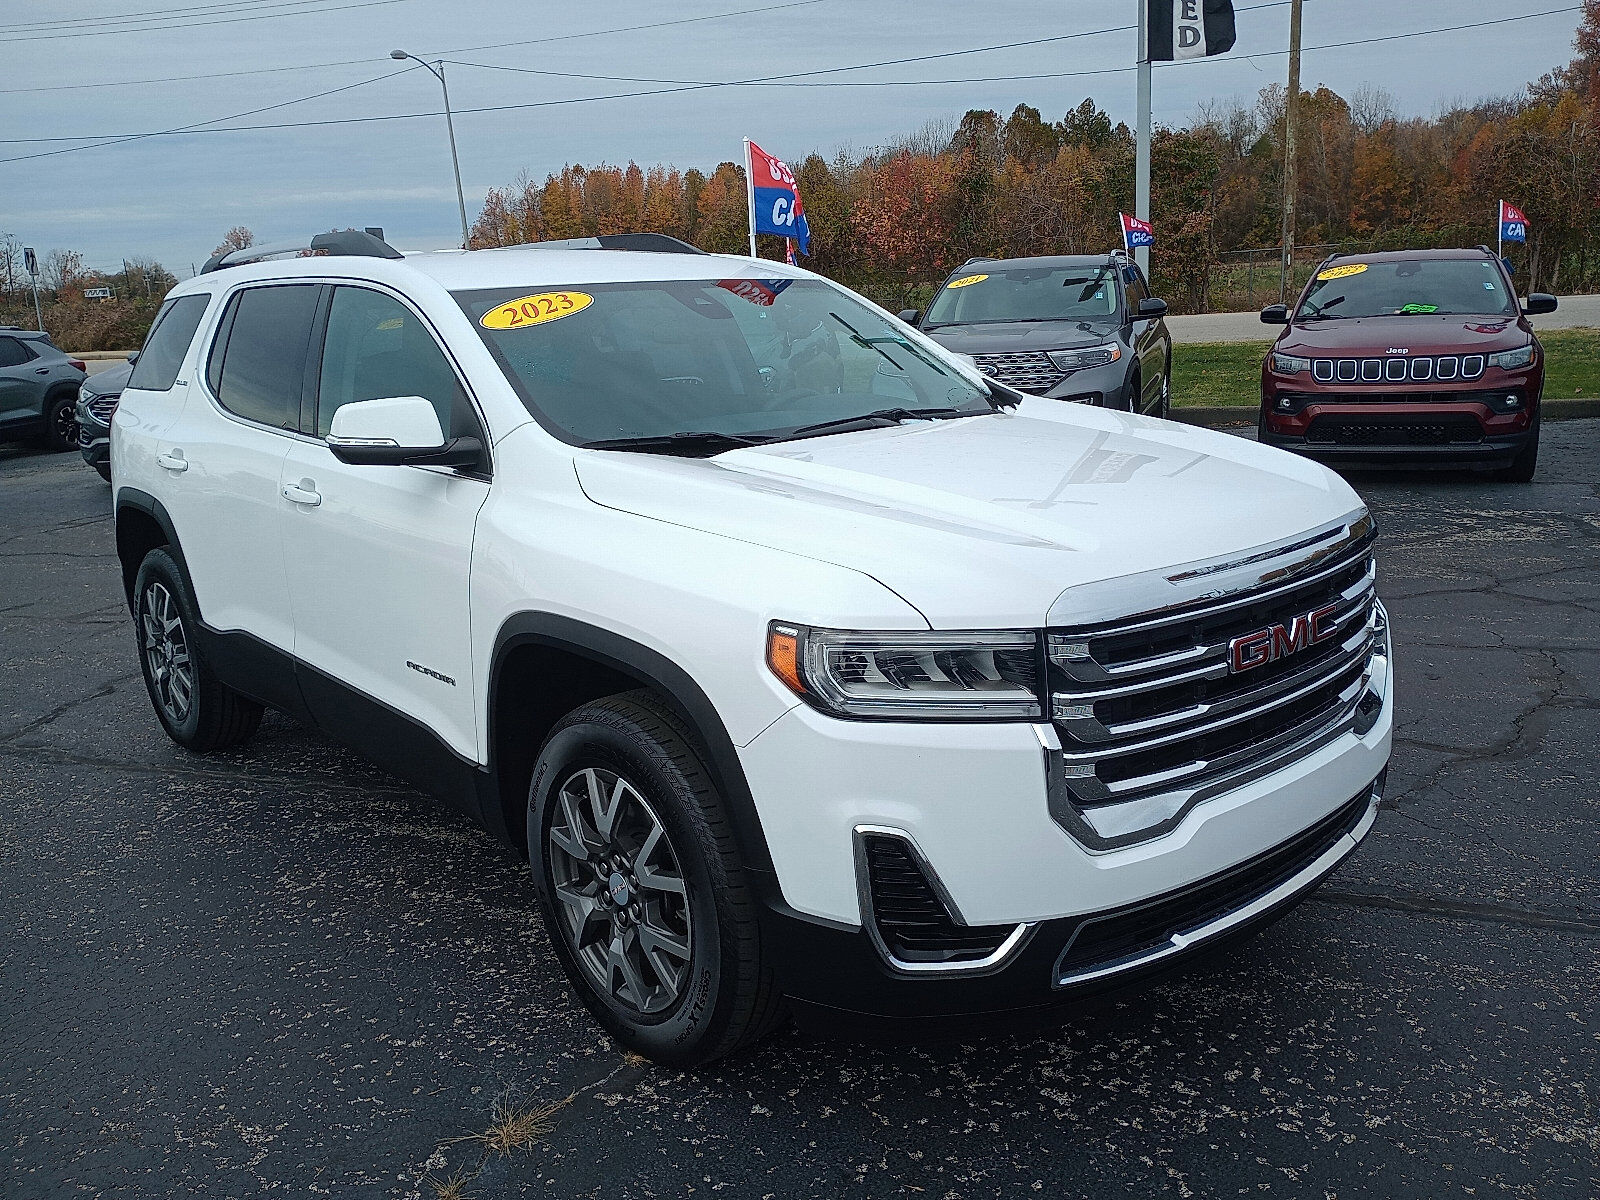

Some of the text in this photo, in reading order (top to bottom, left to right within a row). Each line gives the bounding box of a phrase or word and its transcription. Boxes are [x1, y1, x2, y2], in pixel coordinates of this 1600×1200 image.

[502, 294, 574, 325] 2023
[1385, 346, 1409, 355] Jeep
[1228, 605, 1338, 674] GMC
[406, 660, 456, 687] ACADIA
[688, 1001, 704, 1027] LX
